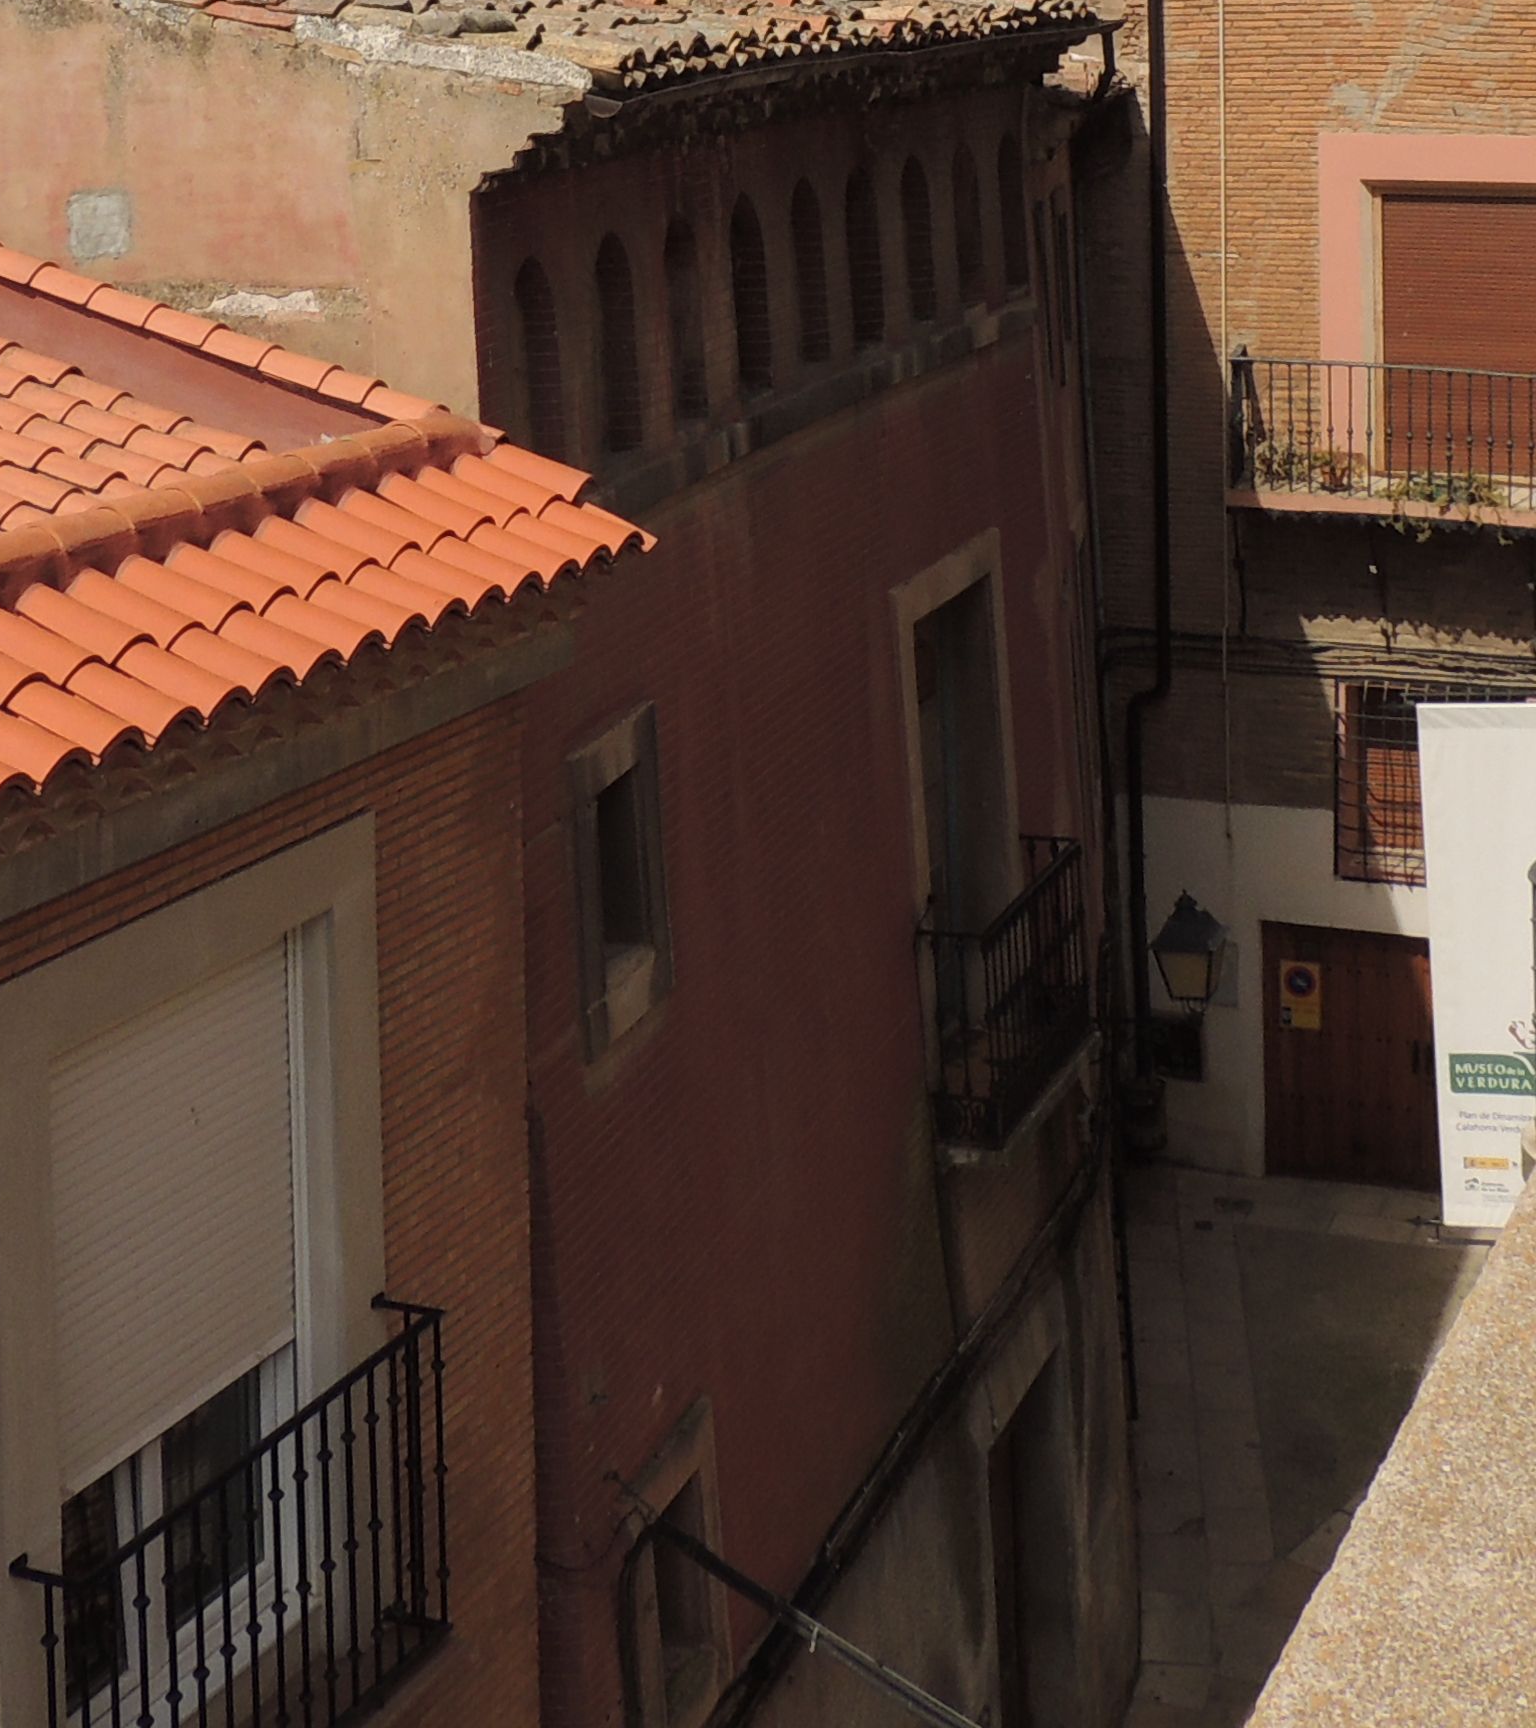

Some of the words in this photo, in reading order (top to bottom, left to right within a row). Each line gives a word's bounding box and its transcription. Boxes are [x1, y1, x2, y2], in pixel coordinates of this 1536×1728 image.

[1455, 1063, 1506, 1075] MUSEO
[1455, 1076, 1532, 1090] VERDURA
[1459, 1111, 1477, 1119] Plan
